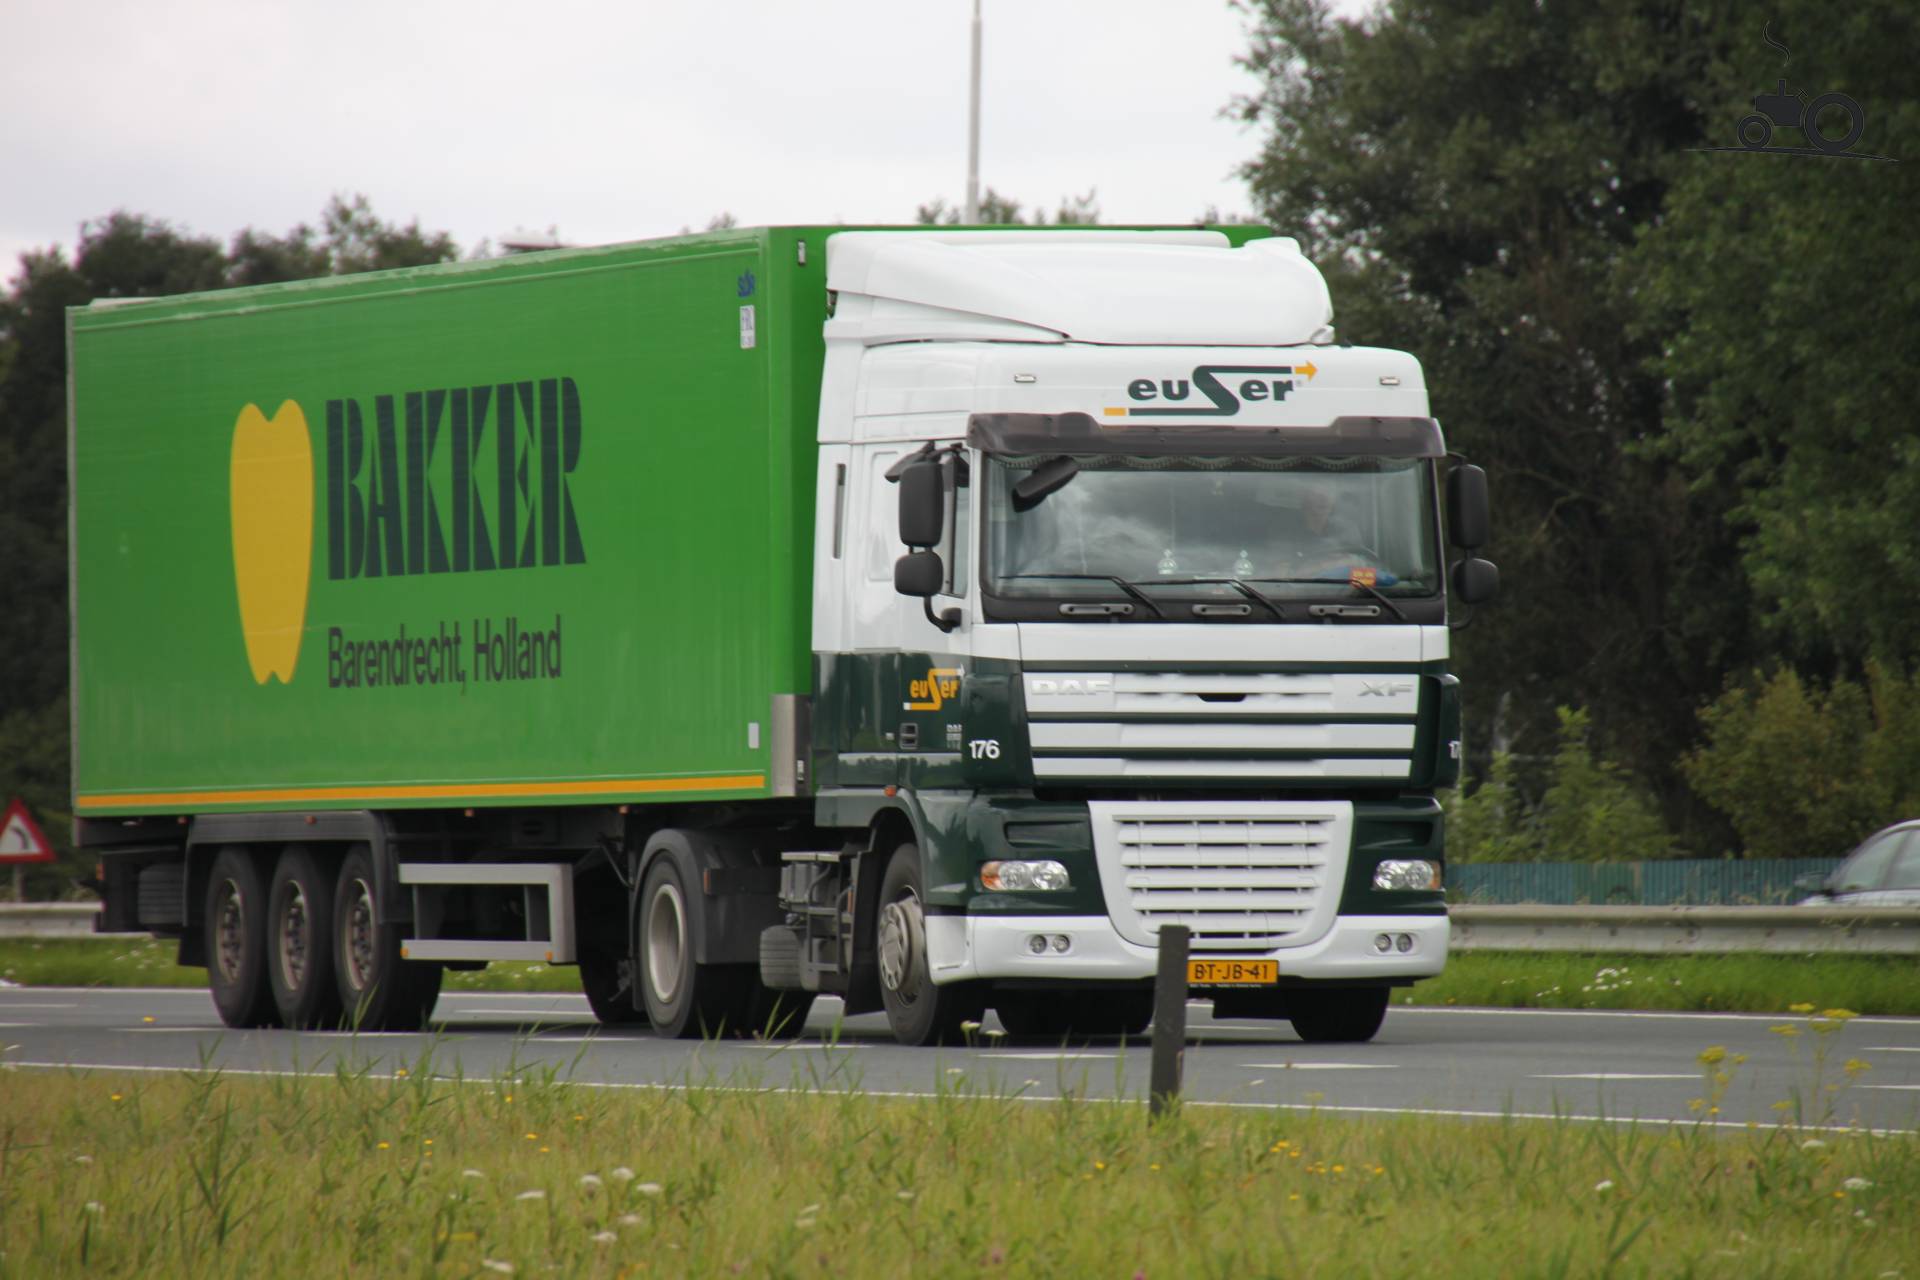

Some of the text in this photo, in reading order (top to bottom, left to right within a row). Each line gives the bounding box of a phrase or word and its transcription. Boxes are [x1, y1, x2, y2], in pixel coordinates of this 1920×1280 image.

[326, 377, 587, 580] BAKKER
[328, 613, 562, 696] Barendrecht, Holland
[1031, 679, 1111, 696] DAF
[1357, 680, 1413, 697] XF
[968, 740, 1000, 759] 176
[1194, 963, 1269, 980] BT-JB-41
